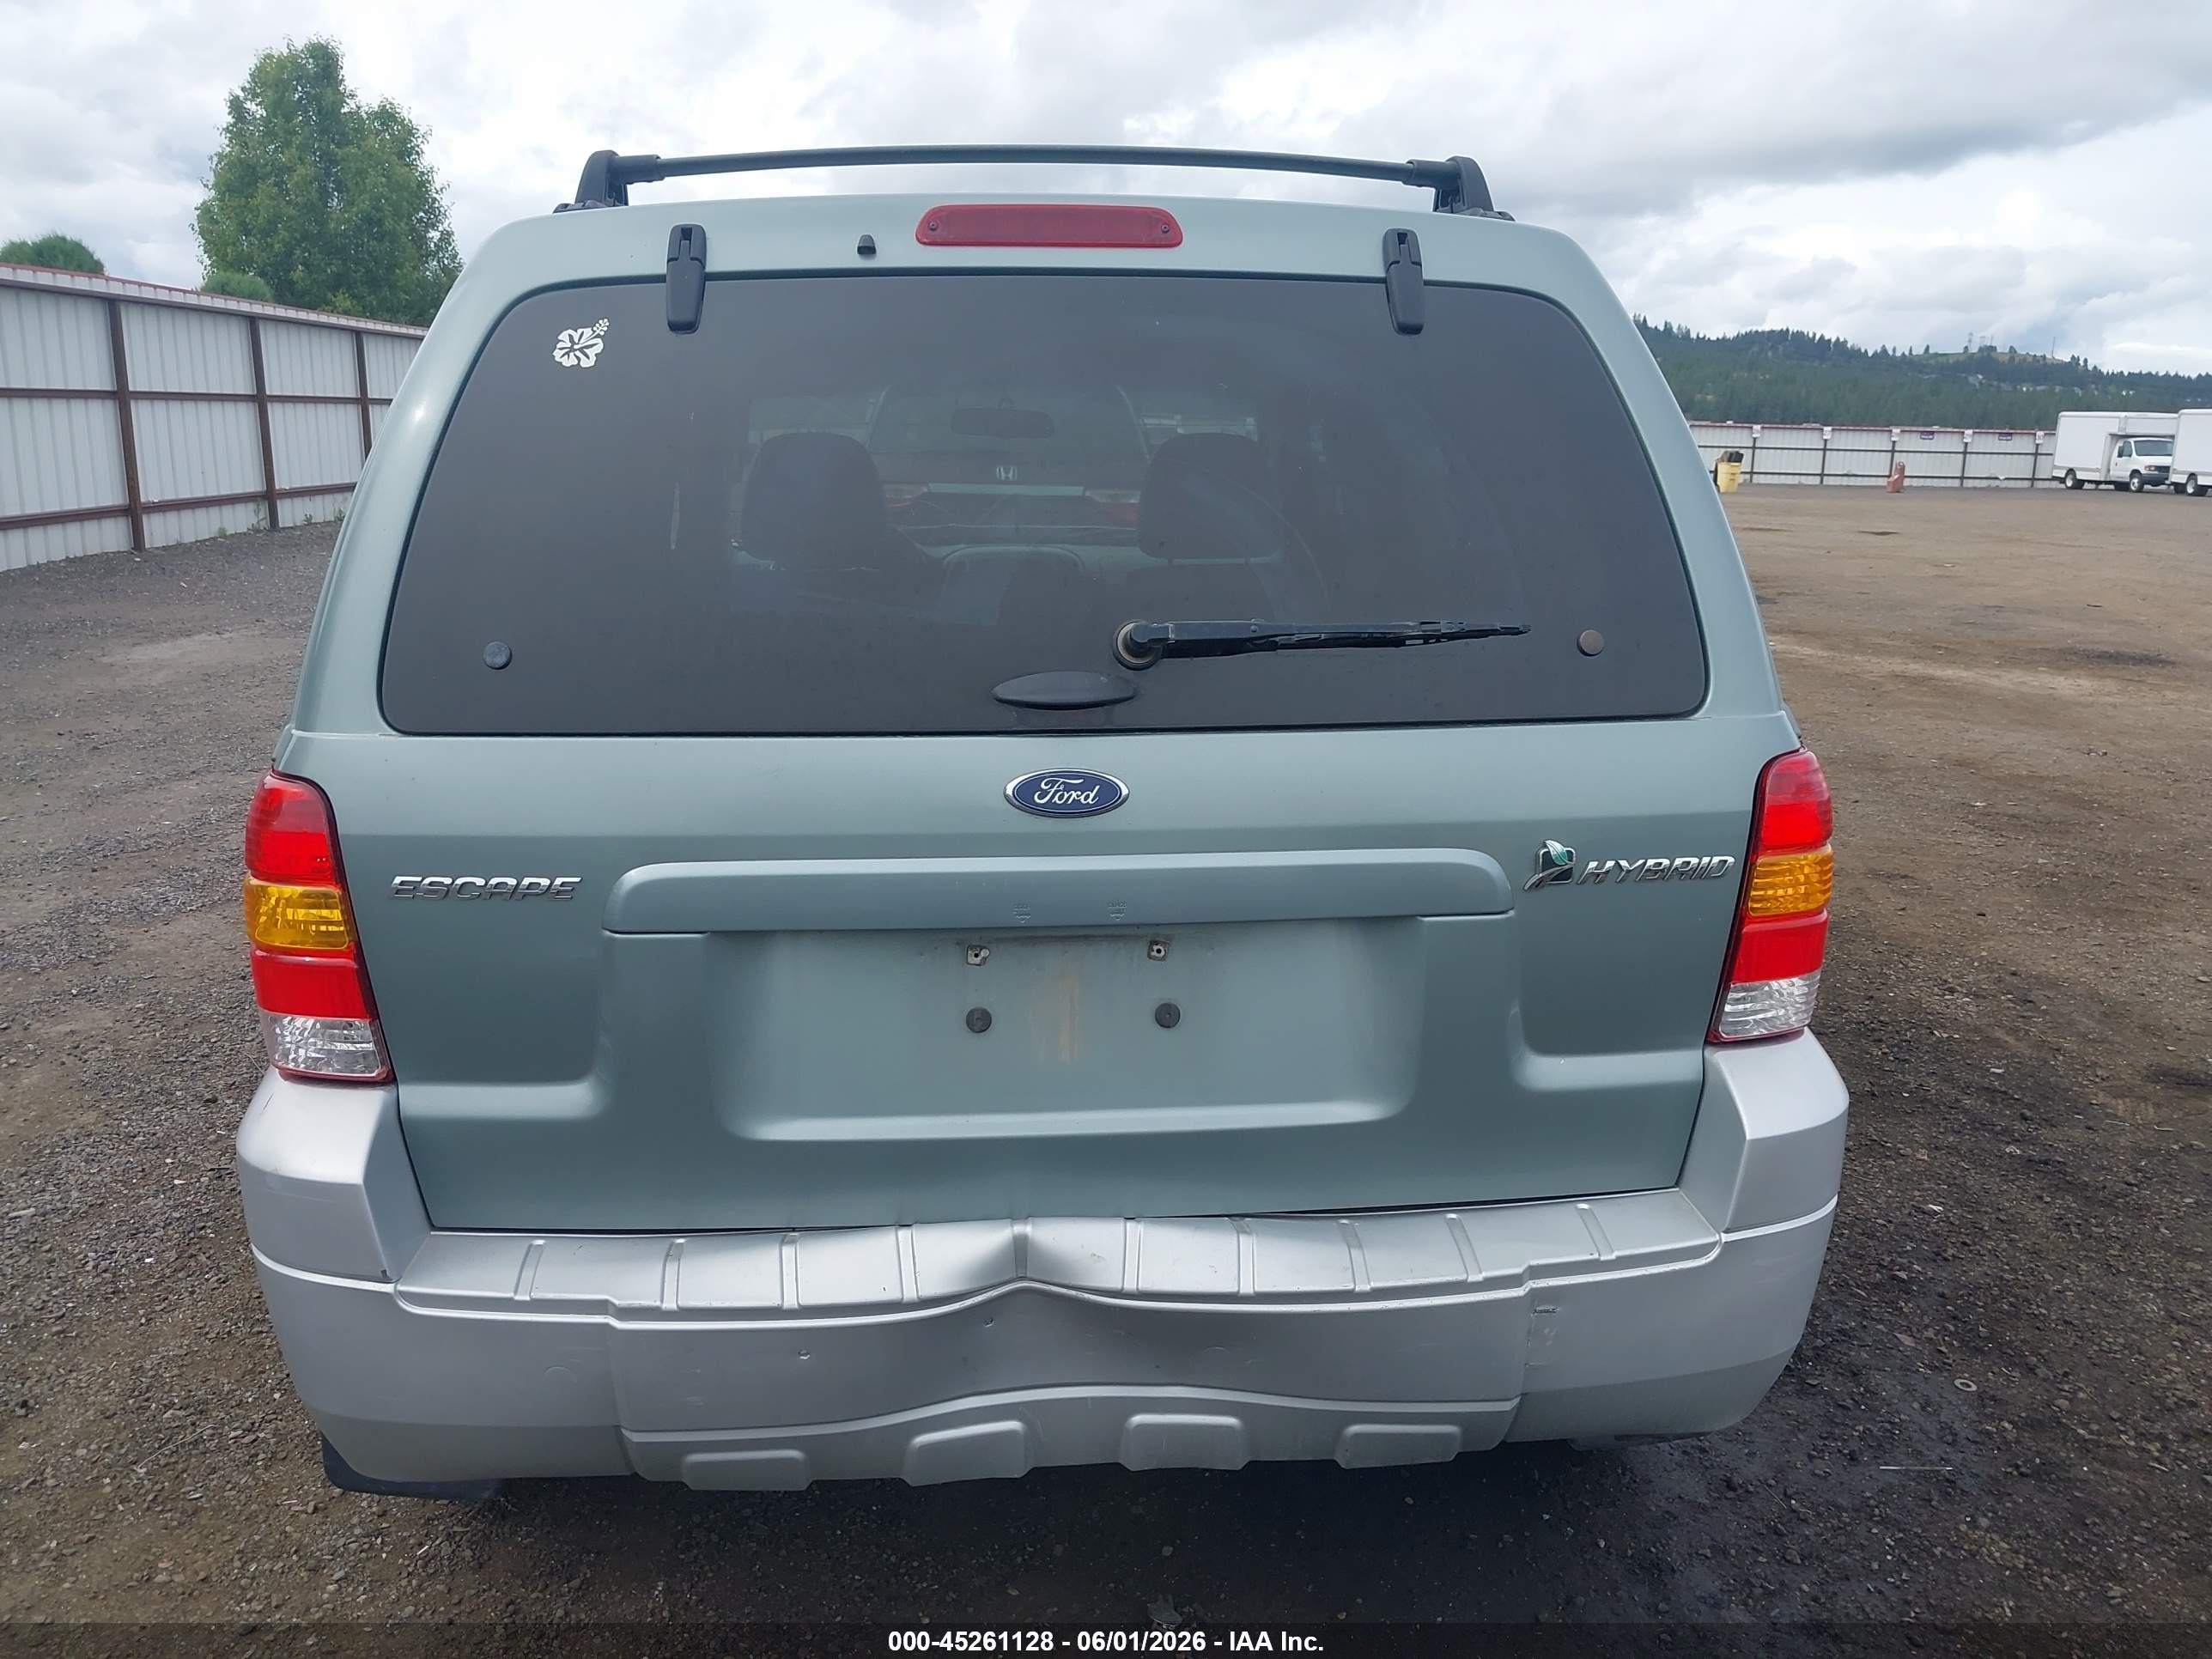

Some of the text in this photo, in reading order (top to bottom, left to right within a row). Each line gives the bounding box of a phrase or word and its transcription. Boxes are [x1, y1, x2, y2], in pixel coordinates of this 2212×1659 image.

[1034, 777, 1100, 805] Ford
[1576, 855, 1735, 885] HYBRID
[391, 875, 583, 901] ESCAPE
